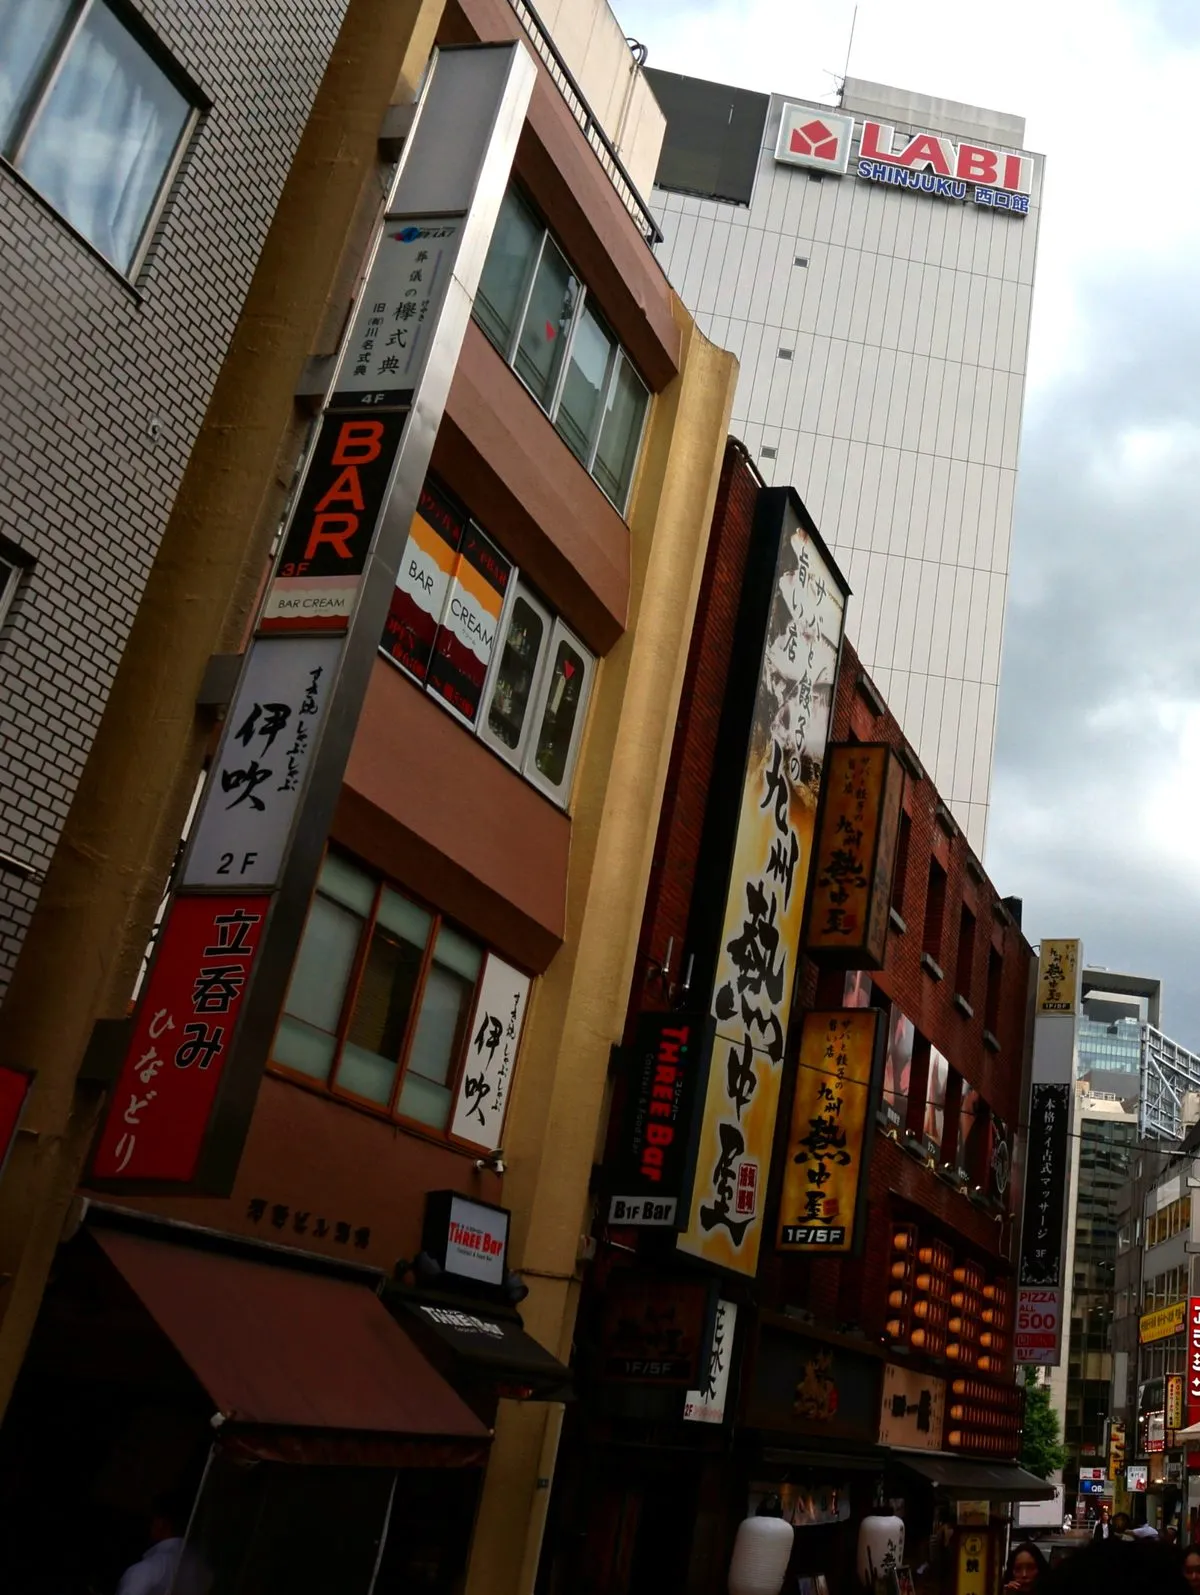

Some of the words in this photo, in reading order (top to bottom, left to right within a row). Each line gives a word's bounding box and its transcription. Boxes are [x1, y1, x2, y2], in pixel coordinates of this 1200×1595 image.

[859, 120, 1034, 194] LABI
[858, 161, 965, 199] SHINJUKU
[974, 186, 1031, 213] 西口館
[360, 393, 386, 405] 4F
[303, 420, 385, 560] BAR
[281, 562, 310, 577] 3F
[408, 560, 435, 595] BAR
[278, 600, 300, 609] BAR
[302, 598, 345, 608] CREAM
[449, 597, 495, 651] CREAM
[221, 702, 292, 812] 伊吹
[215, 853, 258, 875] 2F
[173, 908, 261, 1070] 立呑み
[464, 1011, 503, 1126] 伊吹
[114, 1008, 177, 1174] ひなどり
[1036, 1098, 1057, 1240] 本格タイ古式マッサージ
[641, 1201, 672, 1219] Bar
[448, 1222, 482, 1251] THREE
[785, 1228, 843, 1244] 1F/5F
[1034, 1249, 1048, 1258] 3F
[1019, 1292, 1057, 1303] PIZZA
[1019, 1304, 1036, 1312] ALL
[1018, 1313, 1056, 1330] 500
[624, 1360, 675, 1376] 1F/5F
